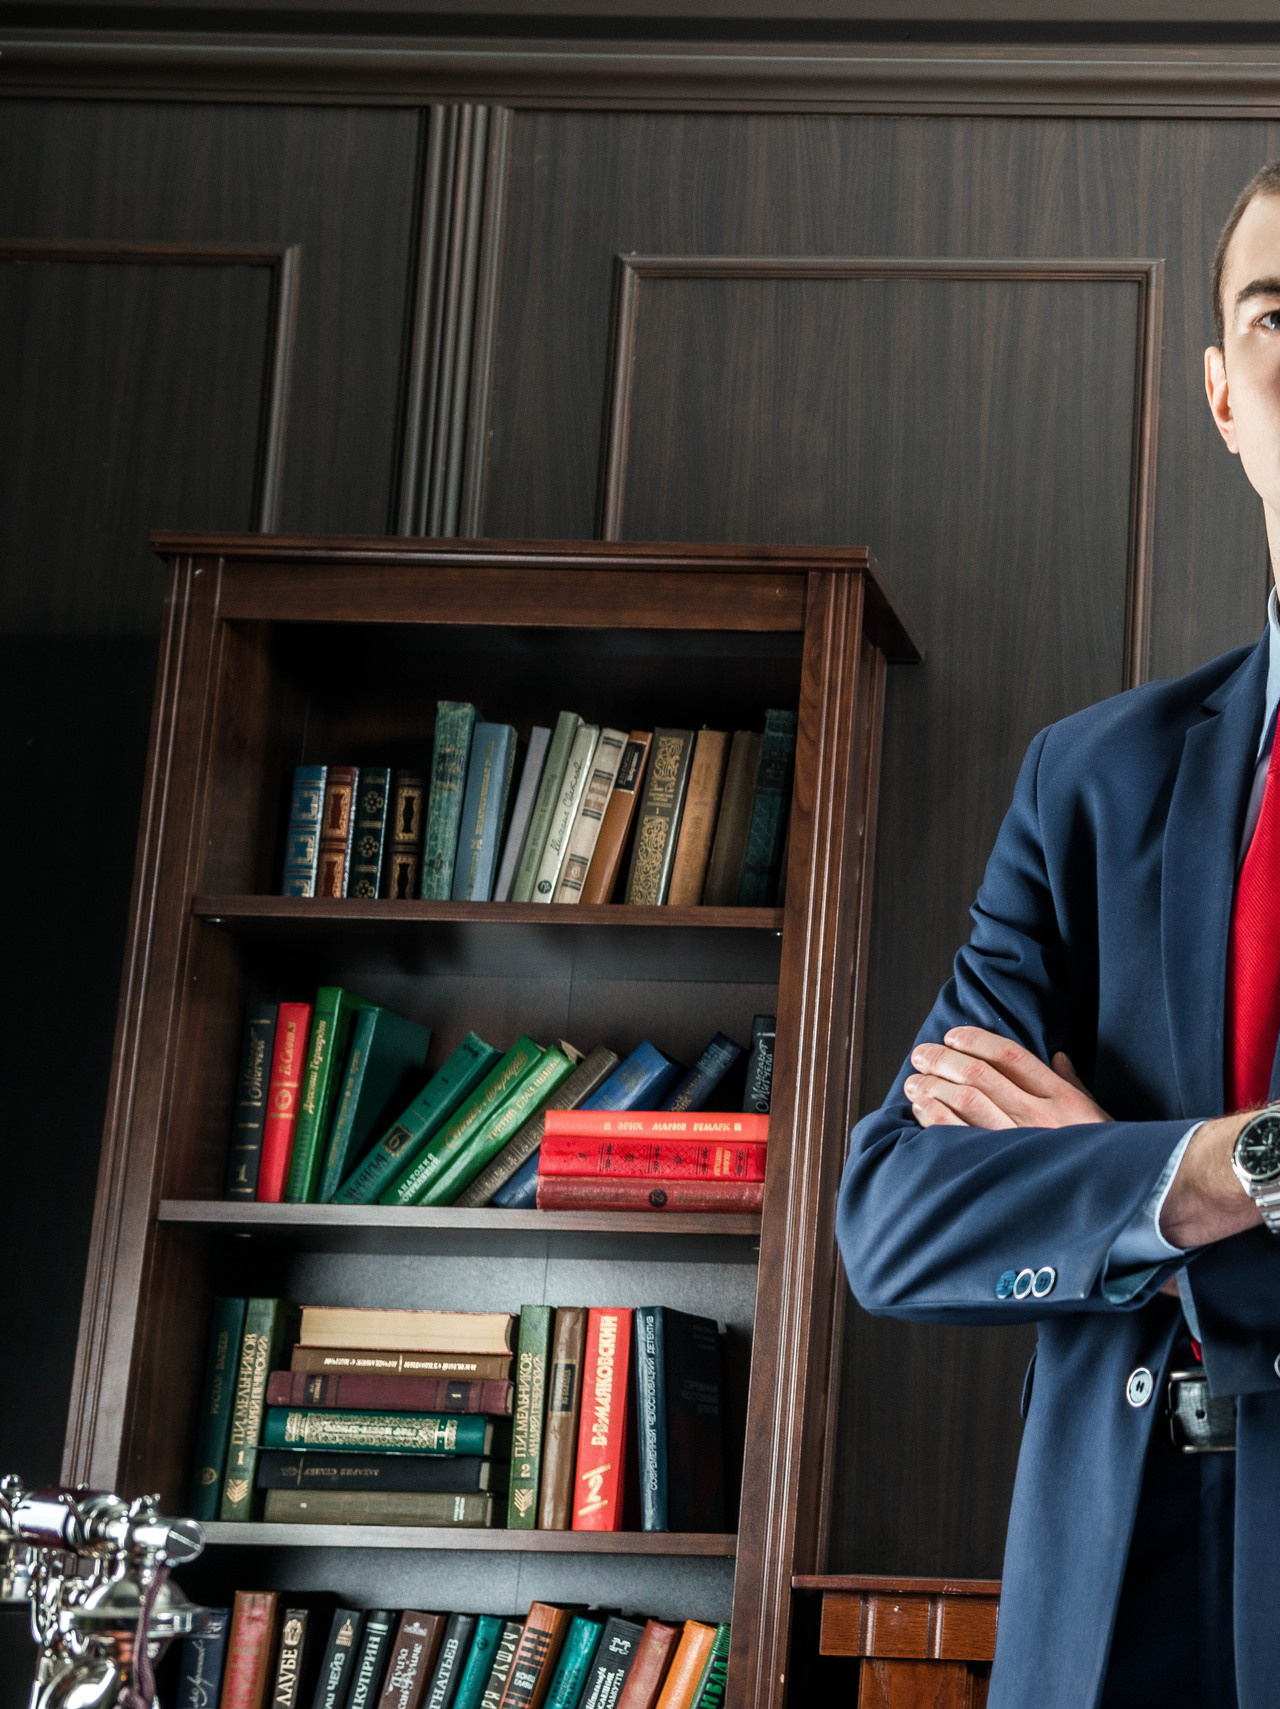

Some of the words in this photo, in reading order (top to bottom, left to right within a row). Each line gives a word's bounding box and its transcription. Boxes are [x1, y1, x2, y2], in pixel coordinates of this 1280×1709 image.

[617, 1122, 643, 1130] ЭРИХ
[652, 1122, 686, 1131] МАРИЯ
[693, 1122, 730, 1131] РЕМАРК
[236, 1165, 248, 1182] 1
[644, 1314, 655, 1354] ДЕТЕКТИВ
[235, 1451, 244, 1466] 1
[521, 1464, 530, 1478] 2
[585, 1476, 604, 1502] 2
[326, 1652, 345, 1692] ЧЕЙЗ
